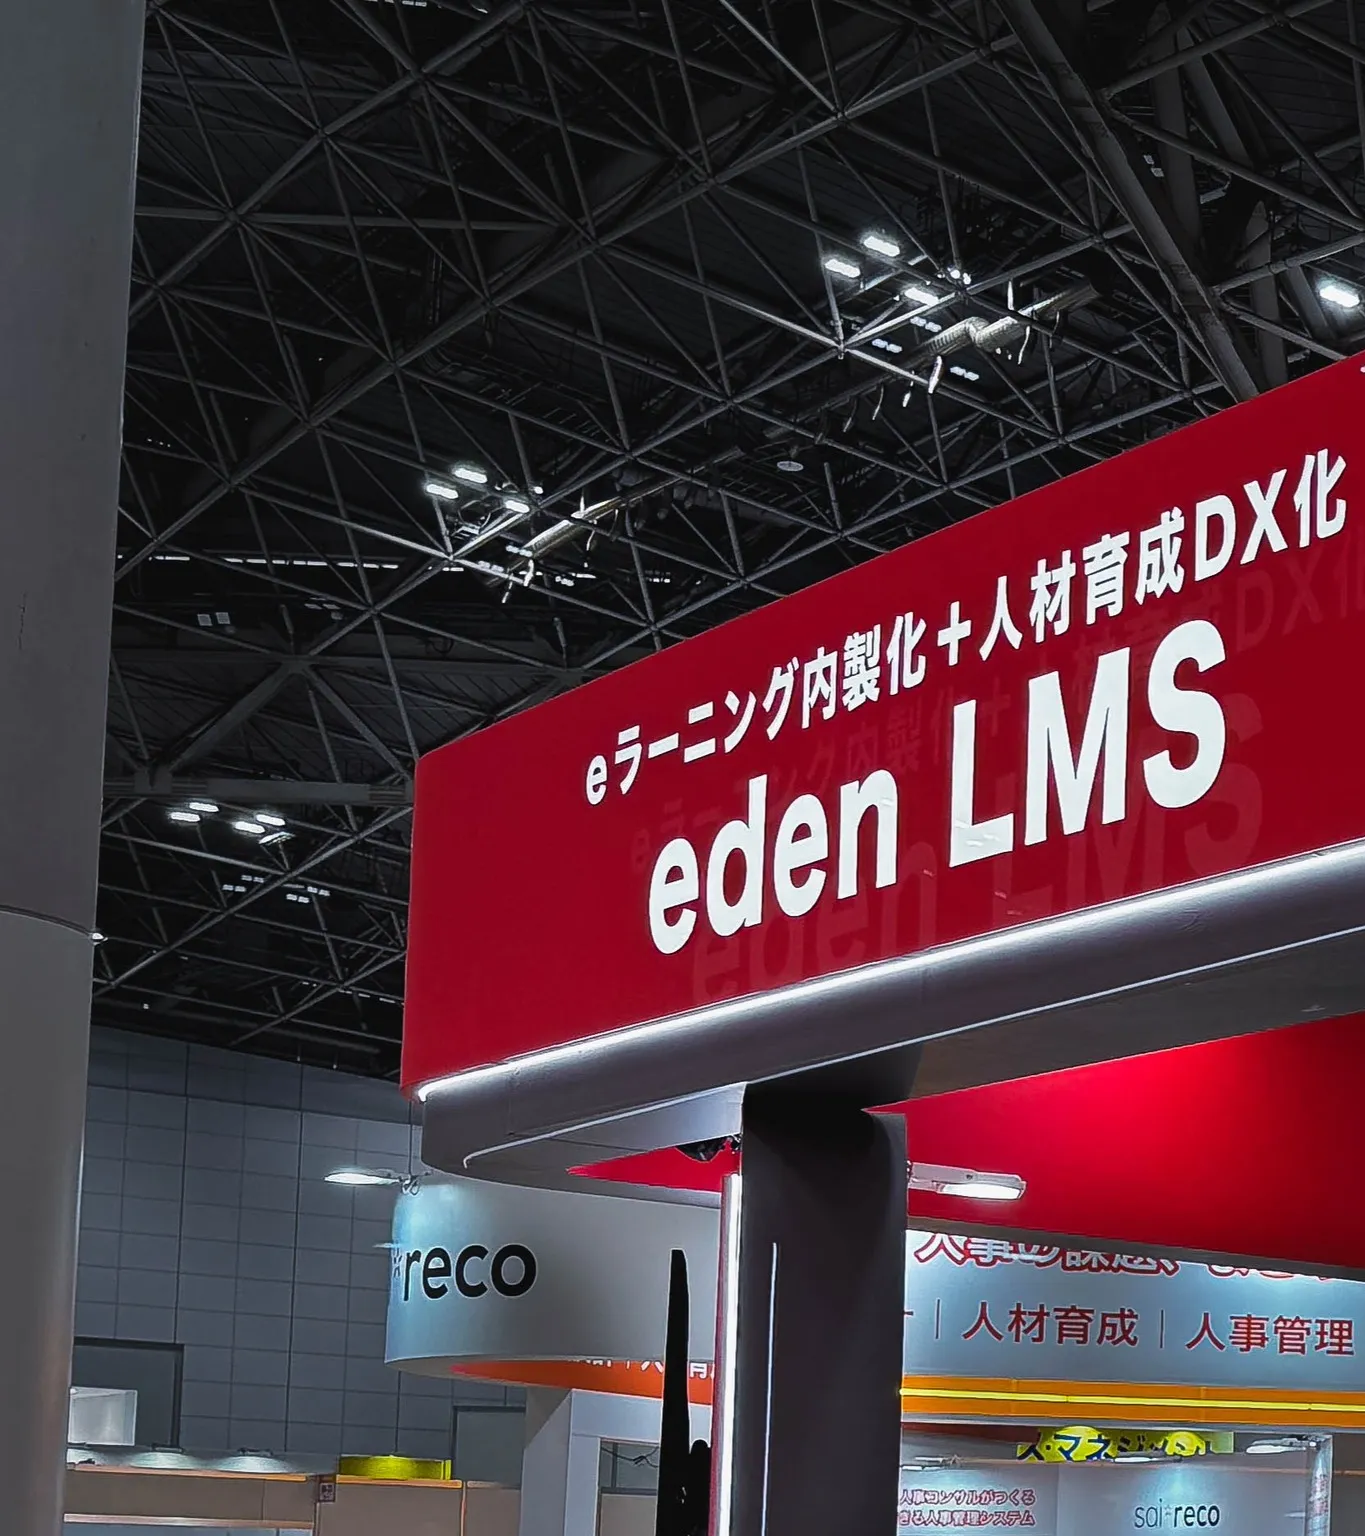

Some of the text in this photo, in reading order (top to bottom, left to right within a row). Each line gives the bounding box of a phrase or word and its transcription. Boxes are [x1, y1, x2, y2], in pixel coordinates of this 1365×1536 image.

[585, 448, 1348, 806] eラーニング内製化+人材育成DX化
[648, 619, 1229, 954] eden LMS
[962, 1301, 1139, 1347] 人材育成
[1185, 1312, 1355, 1357] 人事管理
